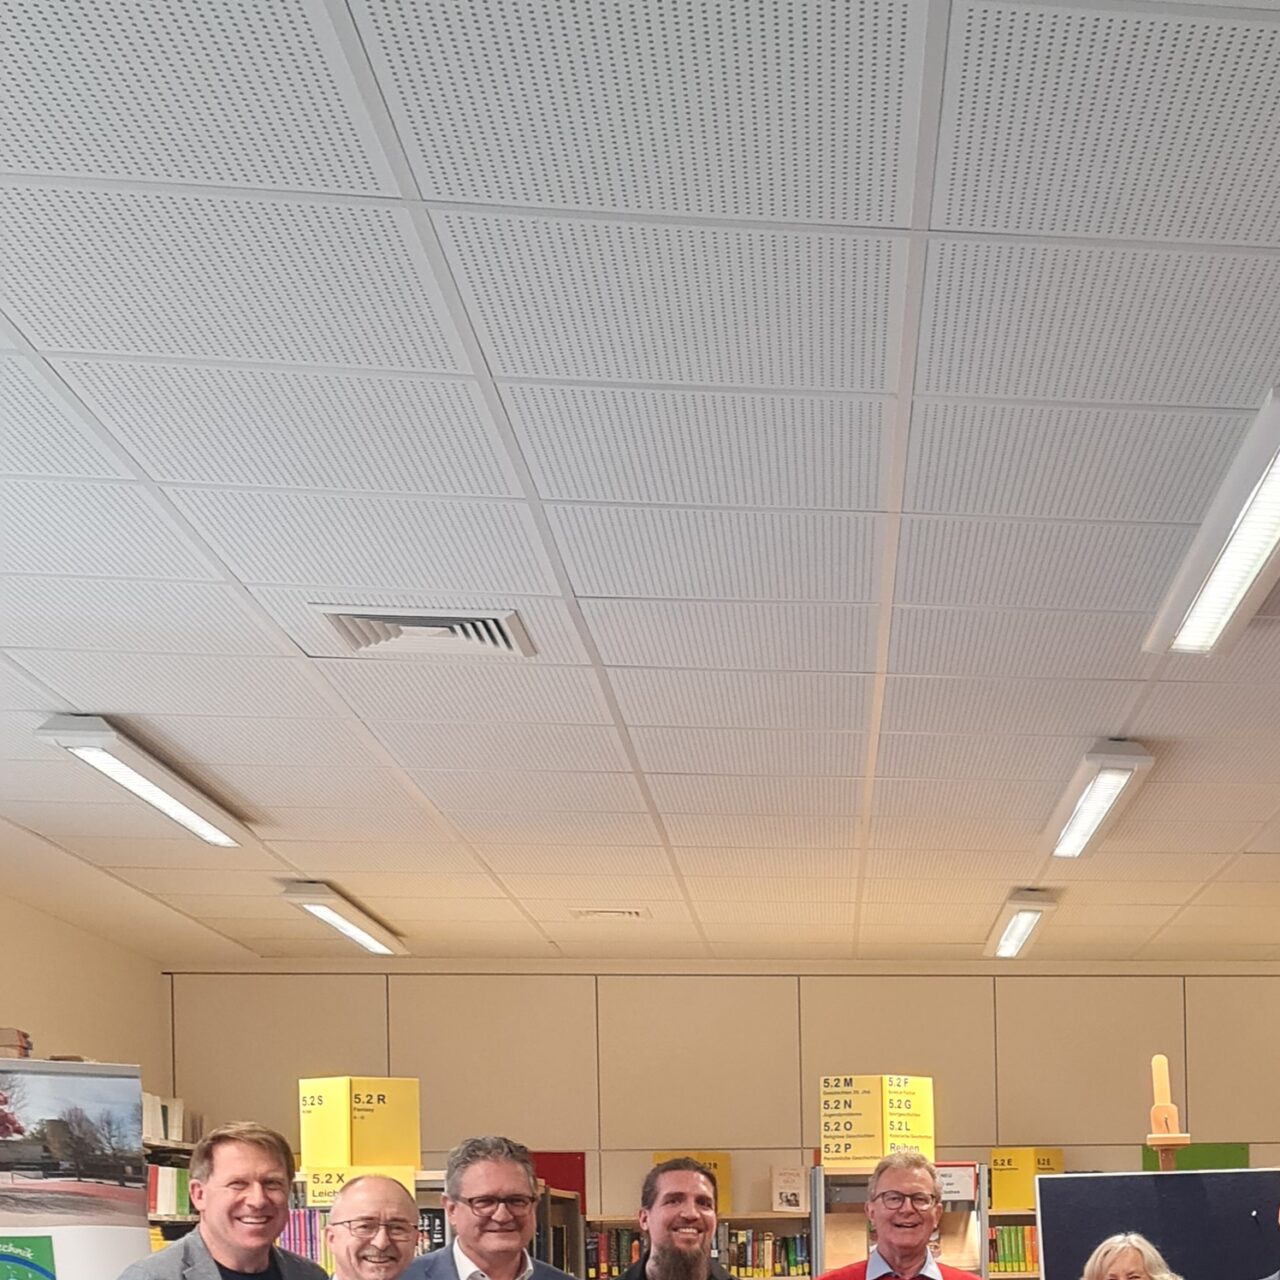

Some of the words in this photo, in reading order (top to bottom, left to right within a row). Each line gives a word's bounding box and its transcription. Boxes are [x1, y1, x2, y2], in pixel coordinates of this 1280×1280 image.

[823, 1077, 841, 1089] 5.2
[843, 1077, 853, 1088] M
[888, 1076, 902, 1088] 5.2
[903, 1077, 909, 1087] F
[301, 1095, 315, 1107] 5.2
[353, 1093, 374, 1105] 5.2
[377, 1094, 387, 1104] R
[823, 1099, 841, 1110] 5.2
[843, 1099, 852, 1109] N
[888, 1098, 902, 1109] 5.2
[904, 1099, 912, 1110] G
[823, 1121, 841, 1132] 5.2
[843, 1120, 853, 1131] O
[889, 1120, 903, 1131] 5.2
[904, 1120, 911, 1132] L
[823, 1143, 841, 1154] 5.2
[844, 1142, 852, 1153] P
[993, 1158, 1006, 1167] 5.2
[311, 1173, 333, 1184] 5.2
[336, 1173, 345, 1184] X
[311, 1189, 339, 1198] Leich
